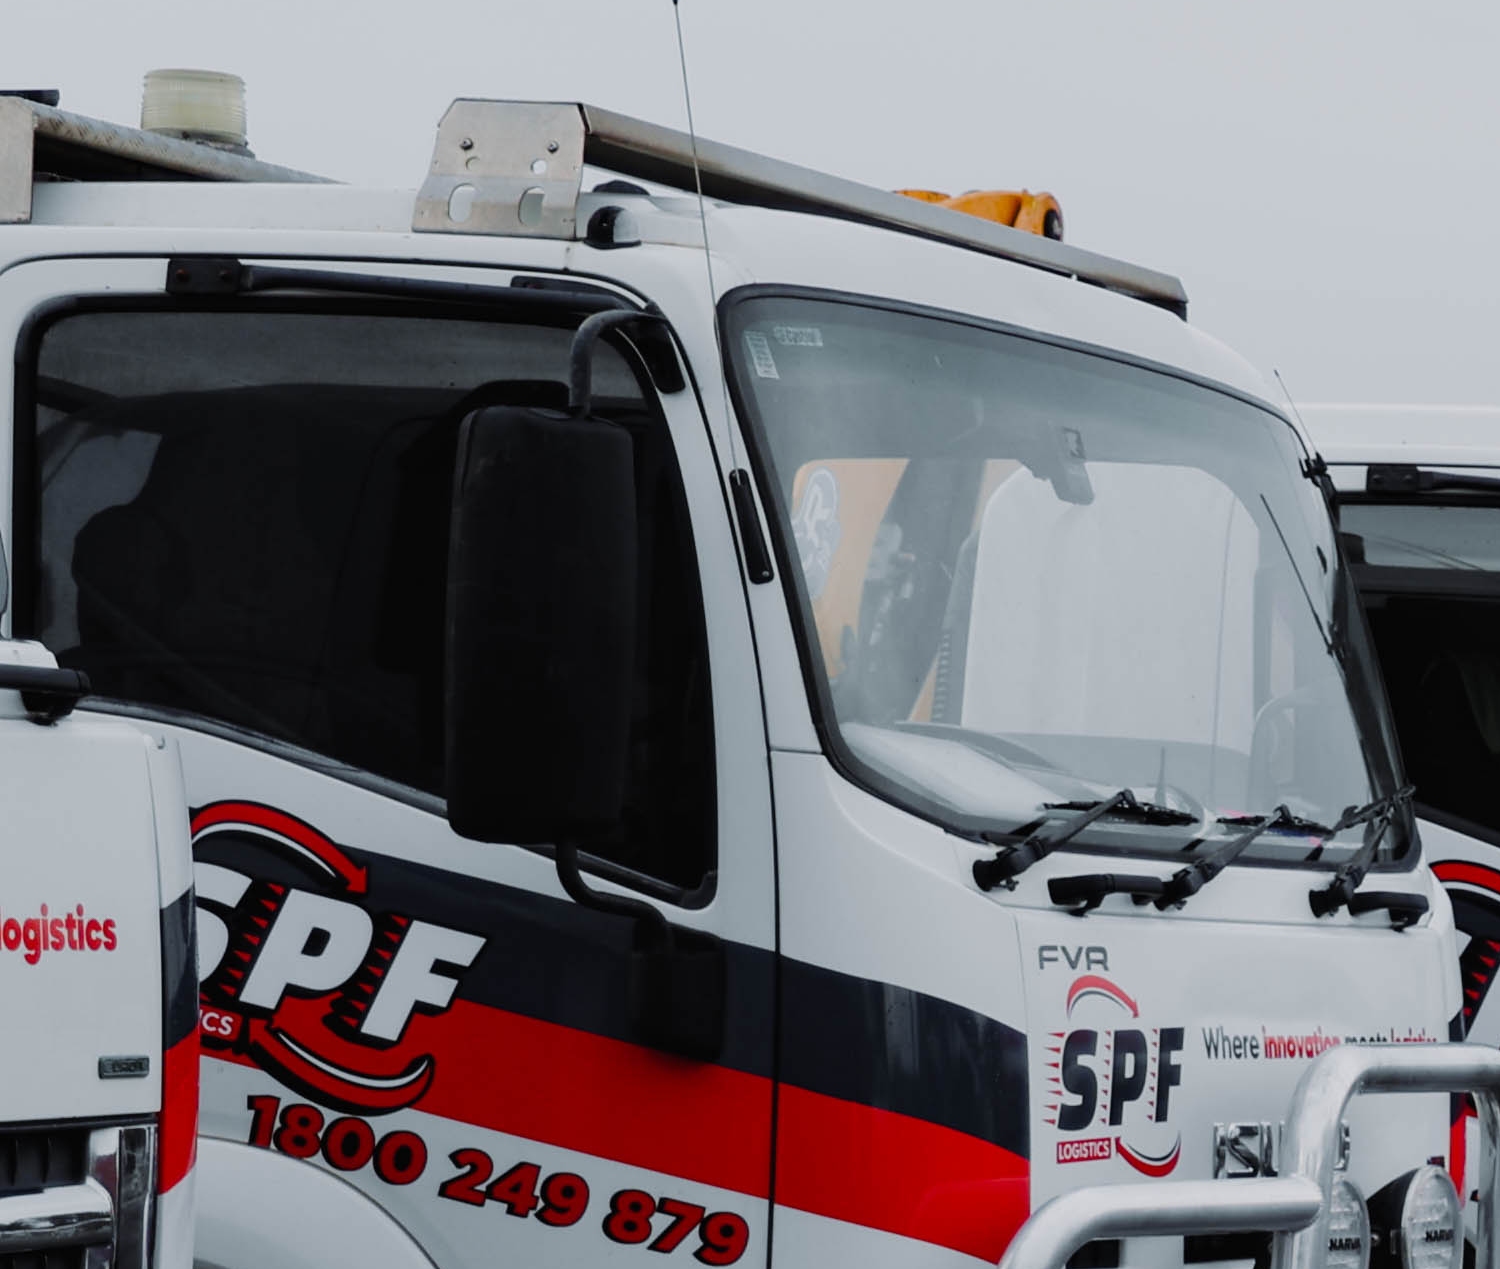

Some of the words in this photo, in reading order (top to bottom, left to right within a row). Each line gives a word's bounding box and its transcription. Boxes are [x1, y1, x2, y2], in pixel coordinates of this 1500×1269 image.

[0, 902, 118, 966] ogistics
[1038, 945, 1110, 972] FVR
[1201, 1025, 1260, 1060] Where
[1057, 1026, 1185, 1132] SPF
[1057, 1138, 1111, 1163] LOGISTICS
[247, 1094, 428, 1186] 1800
[437, 1148, 590, 1227] 249
[601, 1188, 750, 1267] 879
